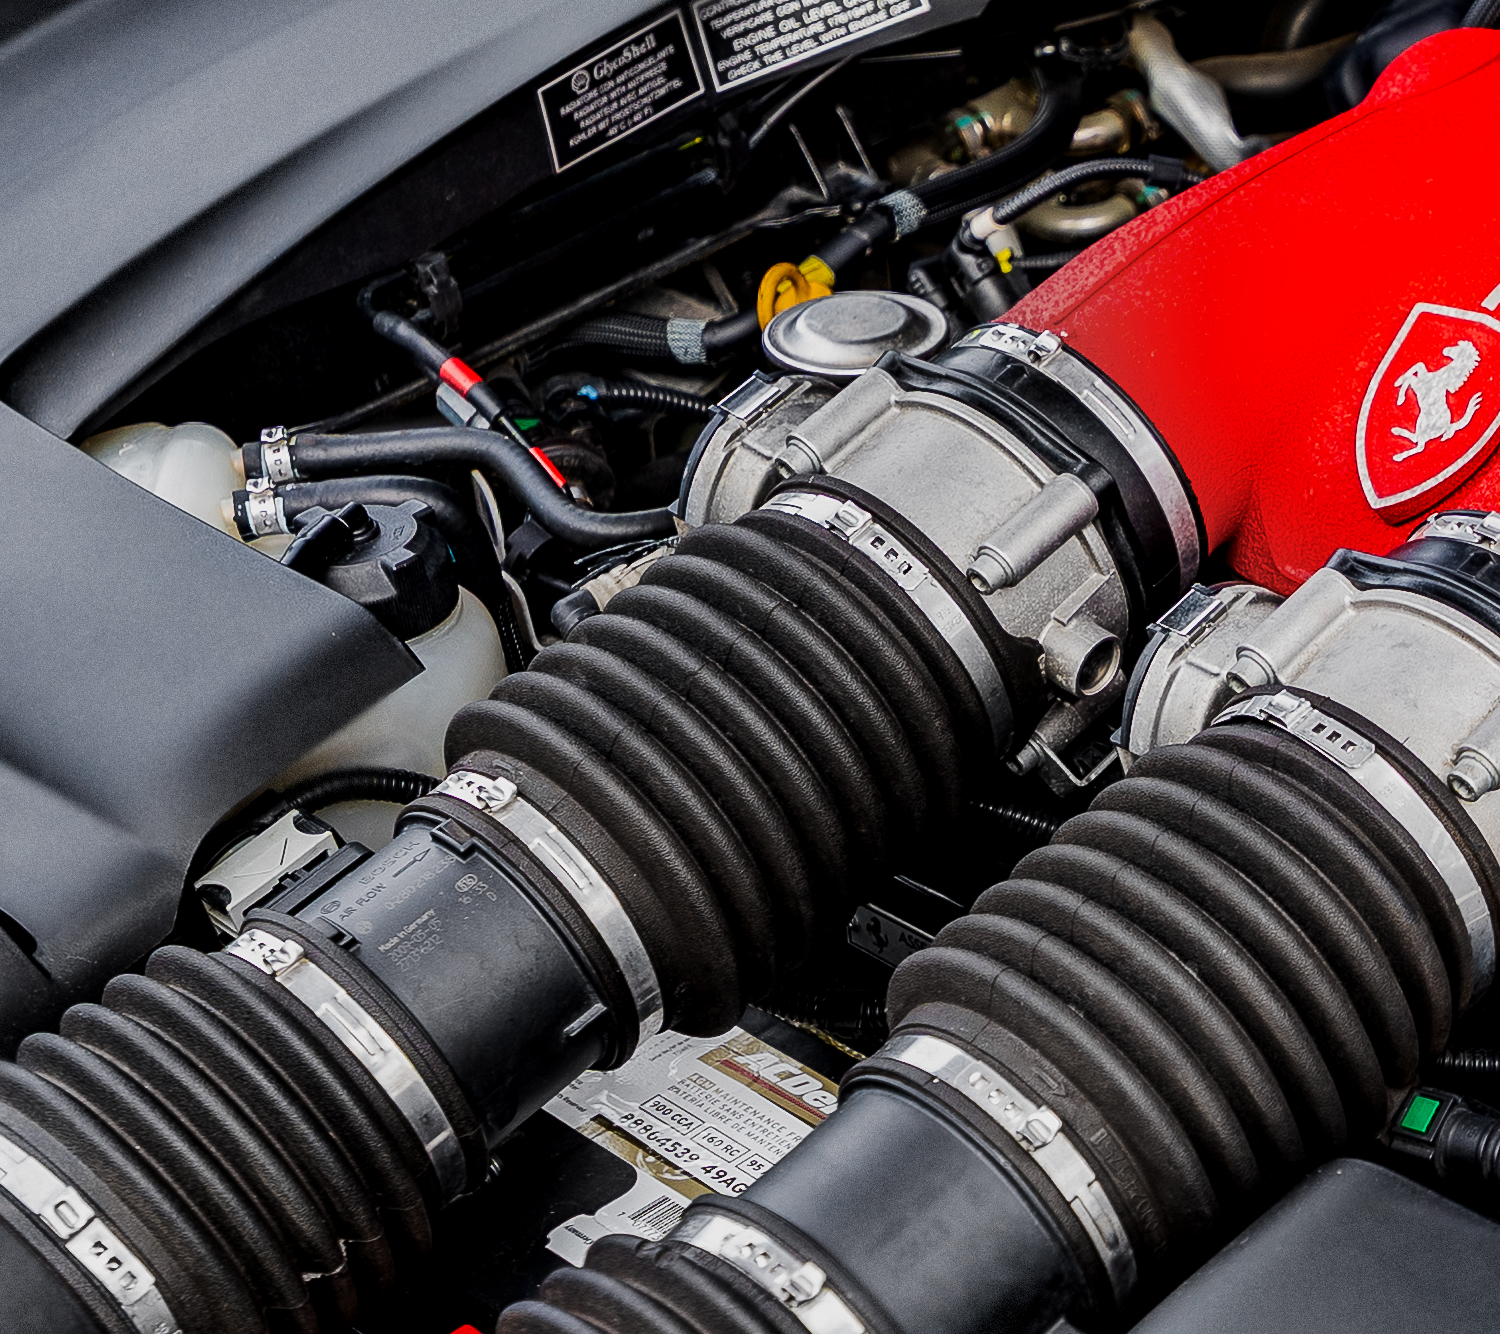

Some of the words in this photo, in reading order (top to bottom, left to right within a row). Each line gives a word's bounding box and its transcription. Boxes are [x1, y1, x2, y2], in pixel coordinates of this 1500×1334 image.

[719, 10, 775, 40] VERIFICARE
[775, 0, 801, 18] CON
[726, 59, 761, 80] CHECK
[763, 50, 784, 66] THE
[785, 36, 817, 57] LEVEL
[819, 25, 847, 44] WITH
[847, 8, 888, 33] ENGINE
[888, 0, 912, 17] OFF
[732, 25, 776, 51] ENGINE
[778, 15, 800, 33] OIL
[801, 0, 841, 24] LEVEL
[593, 33, 658, 80] GlycoShell
[716, 49, 753, 72] ENGINE
[754, 19, 825, 57] TEMPERATURE
[358, 840, 420, 885] BOSCH
[338, 906, 357, 921] AIR
[356, 883, 387, 907] FLOW
[378, 935, 397, 952] Made
[404, 908, 436, 933] Germany
[649, 1099, 674, 1117] 900
[671, 1113, 694, 1130] CCA
[678, 1079, 720, 1108] BATTERIE
[719, 1103, 744, 1121] SANS
[743, 1118, 793, 1150] ENTRETIEN
[689, 1074, 714, 1089] AGM
[713, 1088, 784, 1133] MAINTENANCE
[703, 1106, 730, 1125] LIBRE
[730, 1122, 744, 1133] DE
[620, 1112, 700, 1164] 88864539
[702, 1132, 720, 1147] 160
[721, 1143, 740, 1157] RC
[746, 1159, 764, 1172] 95
